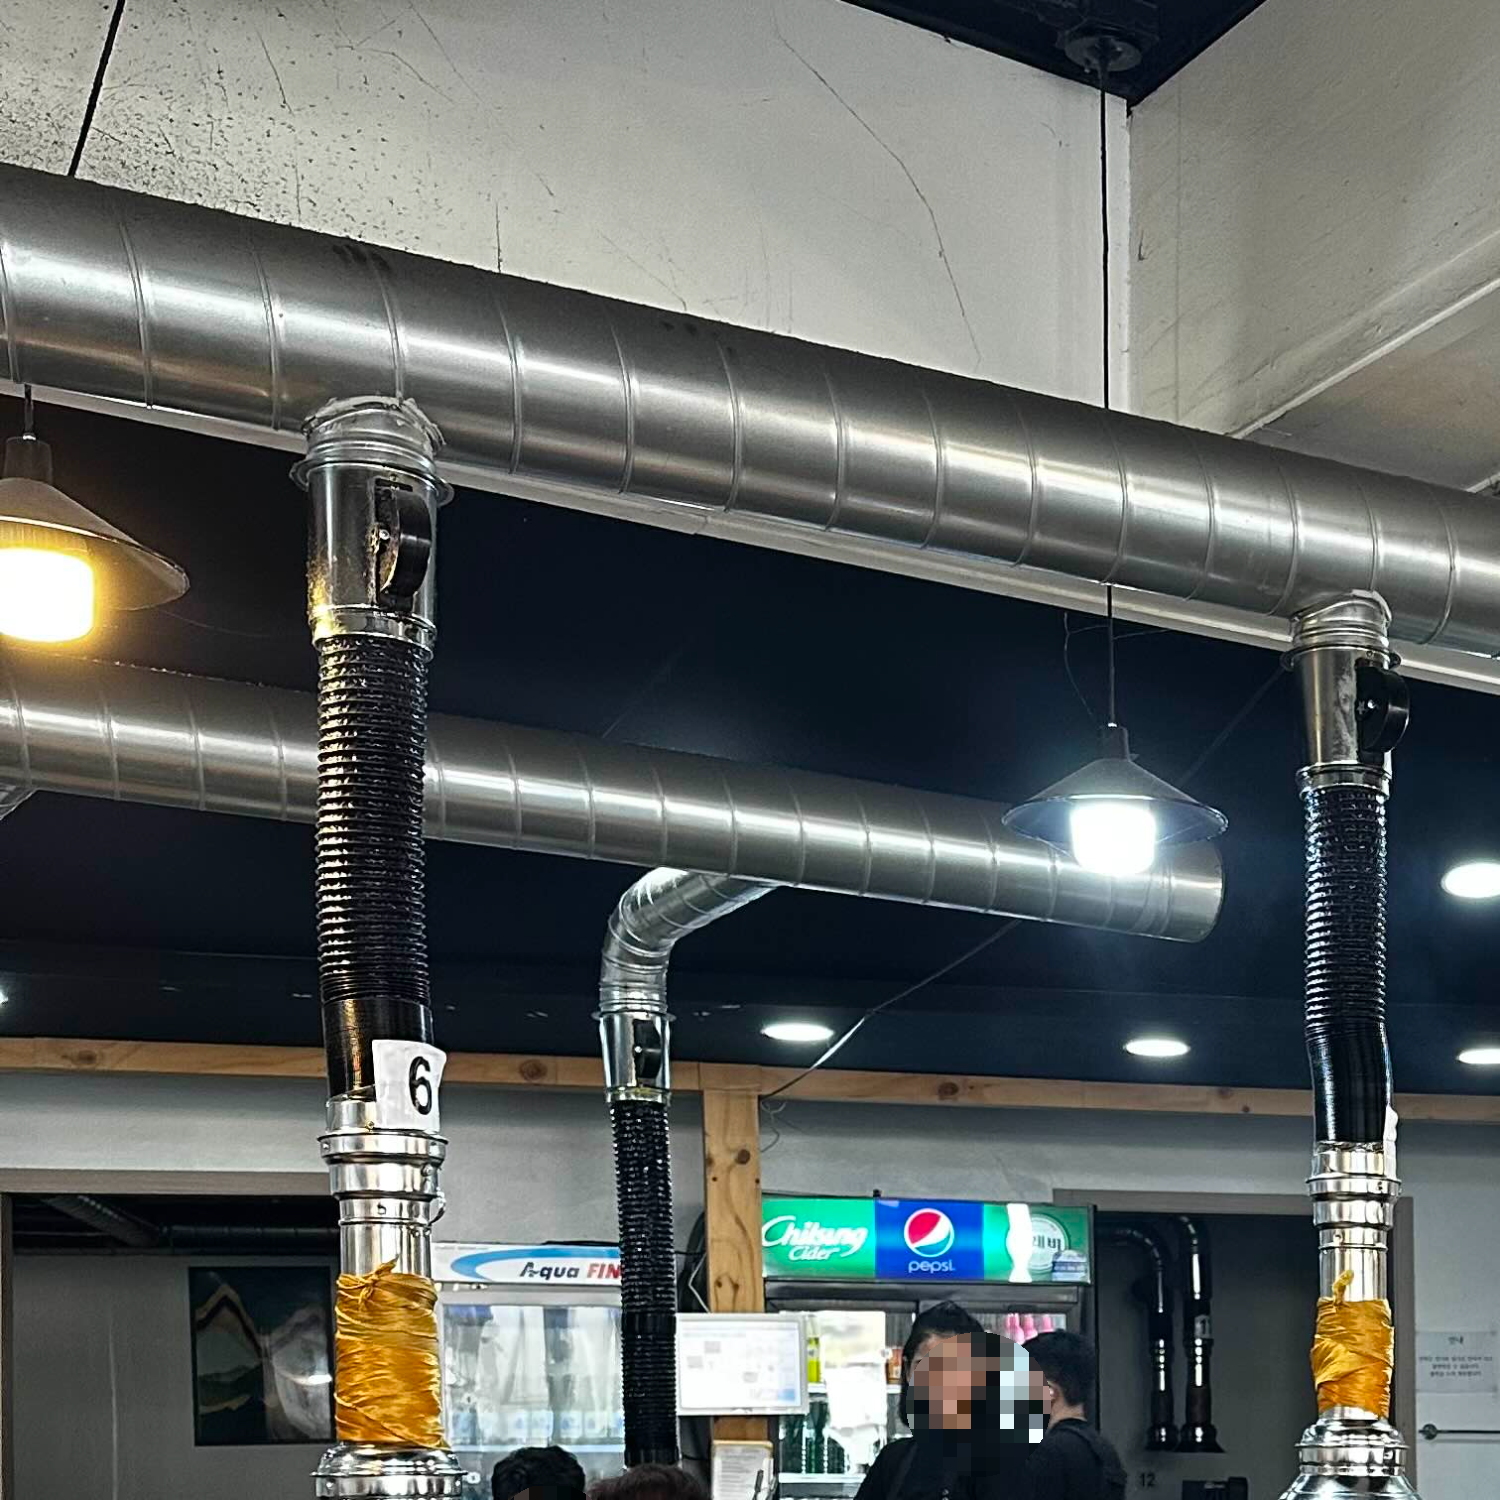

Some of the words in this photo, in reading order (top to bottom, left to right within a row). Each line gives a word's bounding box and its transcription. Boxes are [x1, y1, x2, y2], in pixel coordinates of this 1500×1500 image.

[408, 1055, 433, 1116] 6
[761, 1214, 868, 1258] Chilsung
[787, 1245, 841, 1262] Cider
[519, 1261, 580, 1281] Aqua
[586, 1263, 620, 1280] FIN
[908, 1259, 955, 1274] pepsi
[1139, 1472, 1157, 1488] 12
